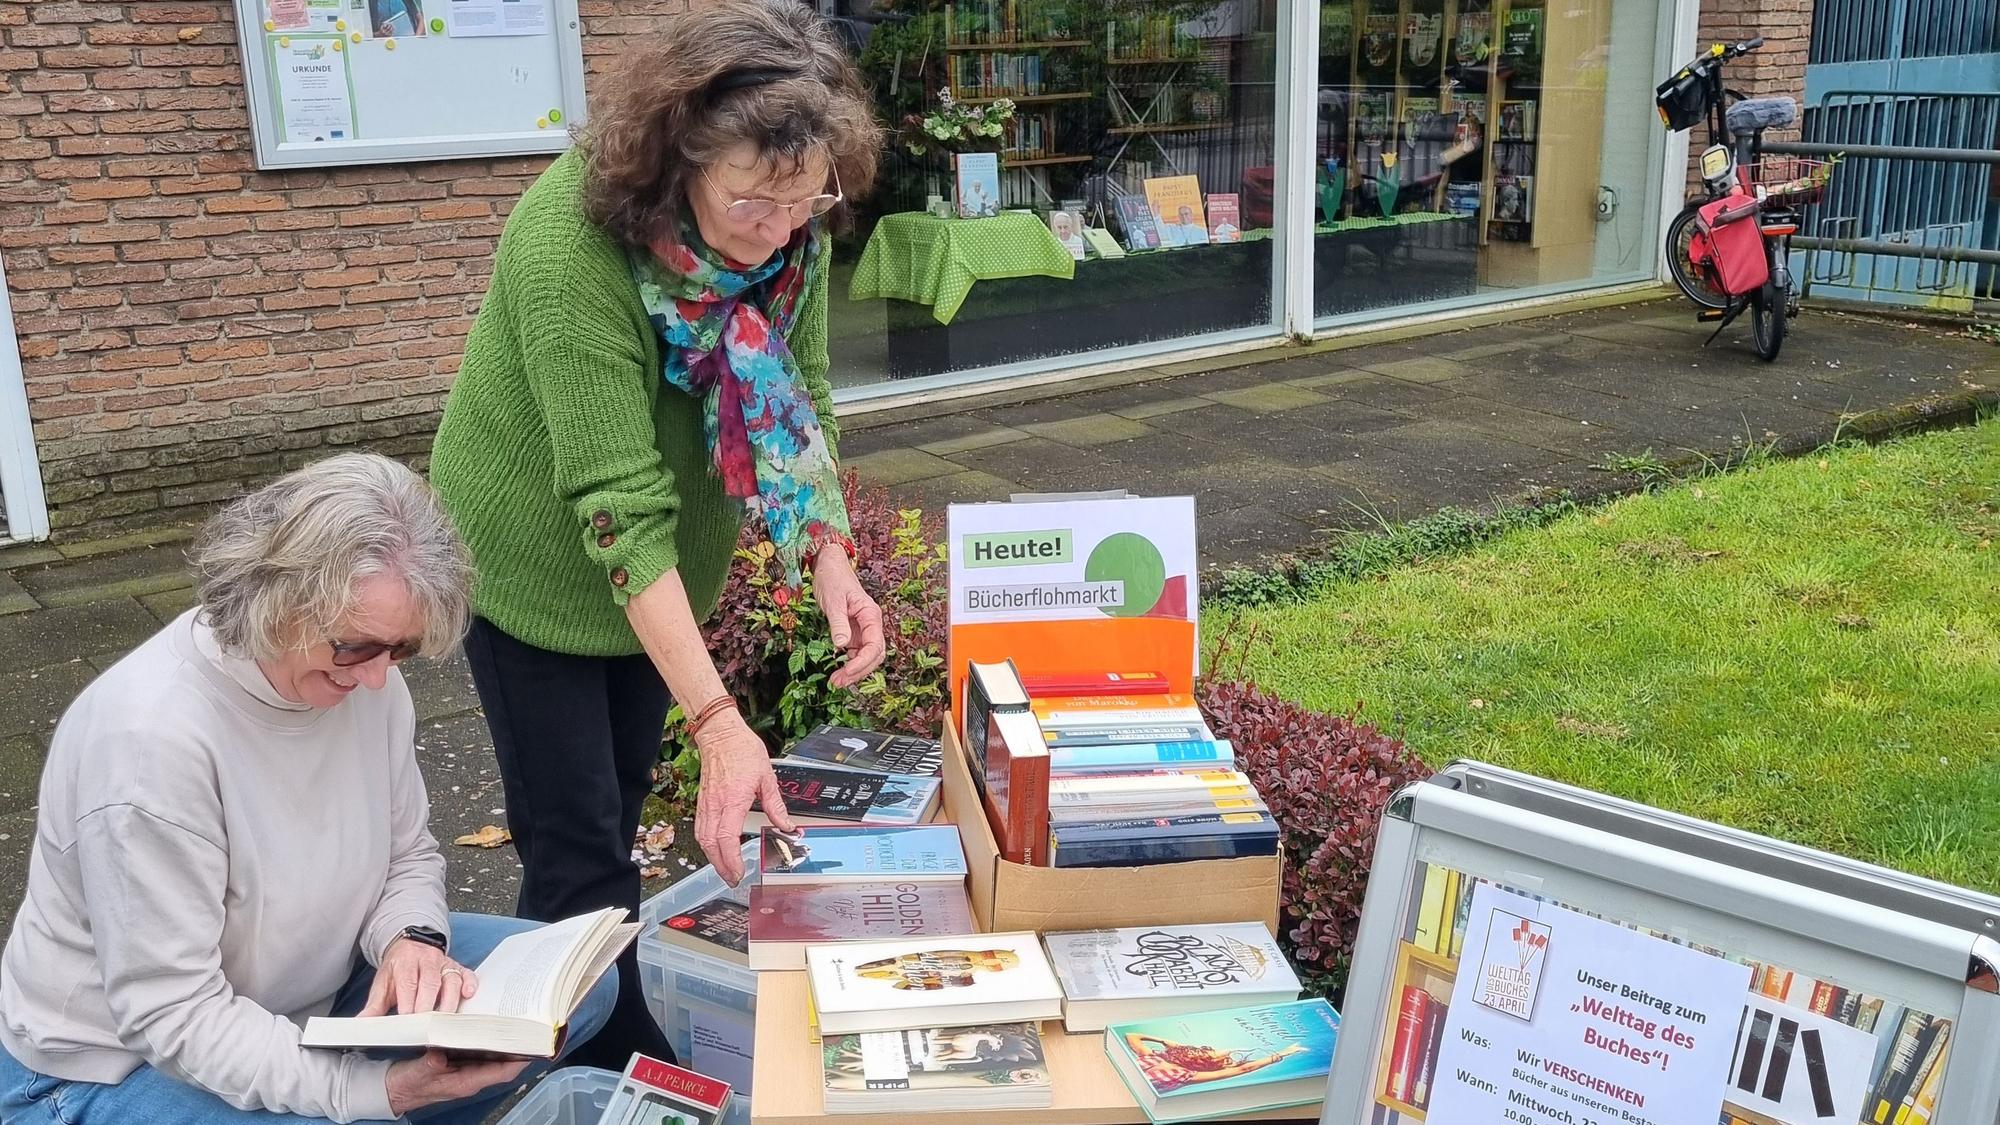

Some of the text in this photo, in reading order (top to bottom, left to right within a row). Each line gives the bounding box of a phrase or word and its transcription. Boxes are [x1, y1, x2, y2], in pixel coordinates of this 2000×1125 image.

[292, 65, 332, 73] URKUNDE
[974, 537, 1062, 561] Heute!
[968, 585, 1117, 608] Bücherflohmarkt
[861, 893, 896, 926] HILL
[895, 883, 924, 936] GOLDEN
[1488, 963, 1531, 985] WELTTAG
[1495, 981, 1529, 998] BUCHES
[1577, 969, 1707, 1024] Unser Beitrag zum
[1484, 993, 1527, 1014] 23. APRIL
[1570, 995, 1695, 1050] „Welttag des
[1461, 1027, 1492, 1049] Was:
[1583, 1027, 1670, 1071] Buches“!
[664, 1074, 706, 1096] PEARCE
[866, 1080, 904, 1090] PIPER
[1456, 1068, 1498, 1095] Wann:
[1517, 1049, 1645, 1107] Wir VERSCHENKEN
[1512, 1067, 1548, 1089] Bücher
[1550, 1084, 1569, 1098] aus
[1571, 1092, 1619, 1117] unserem
[1503, 1108, 1533, 1125] 10.00
